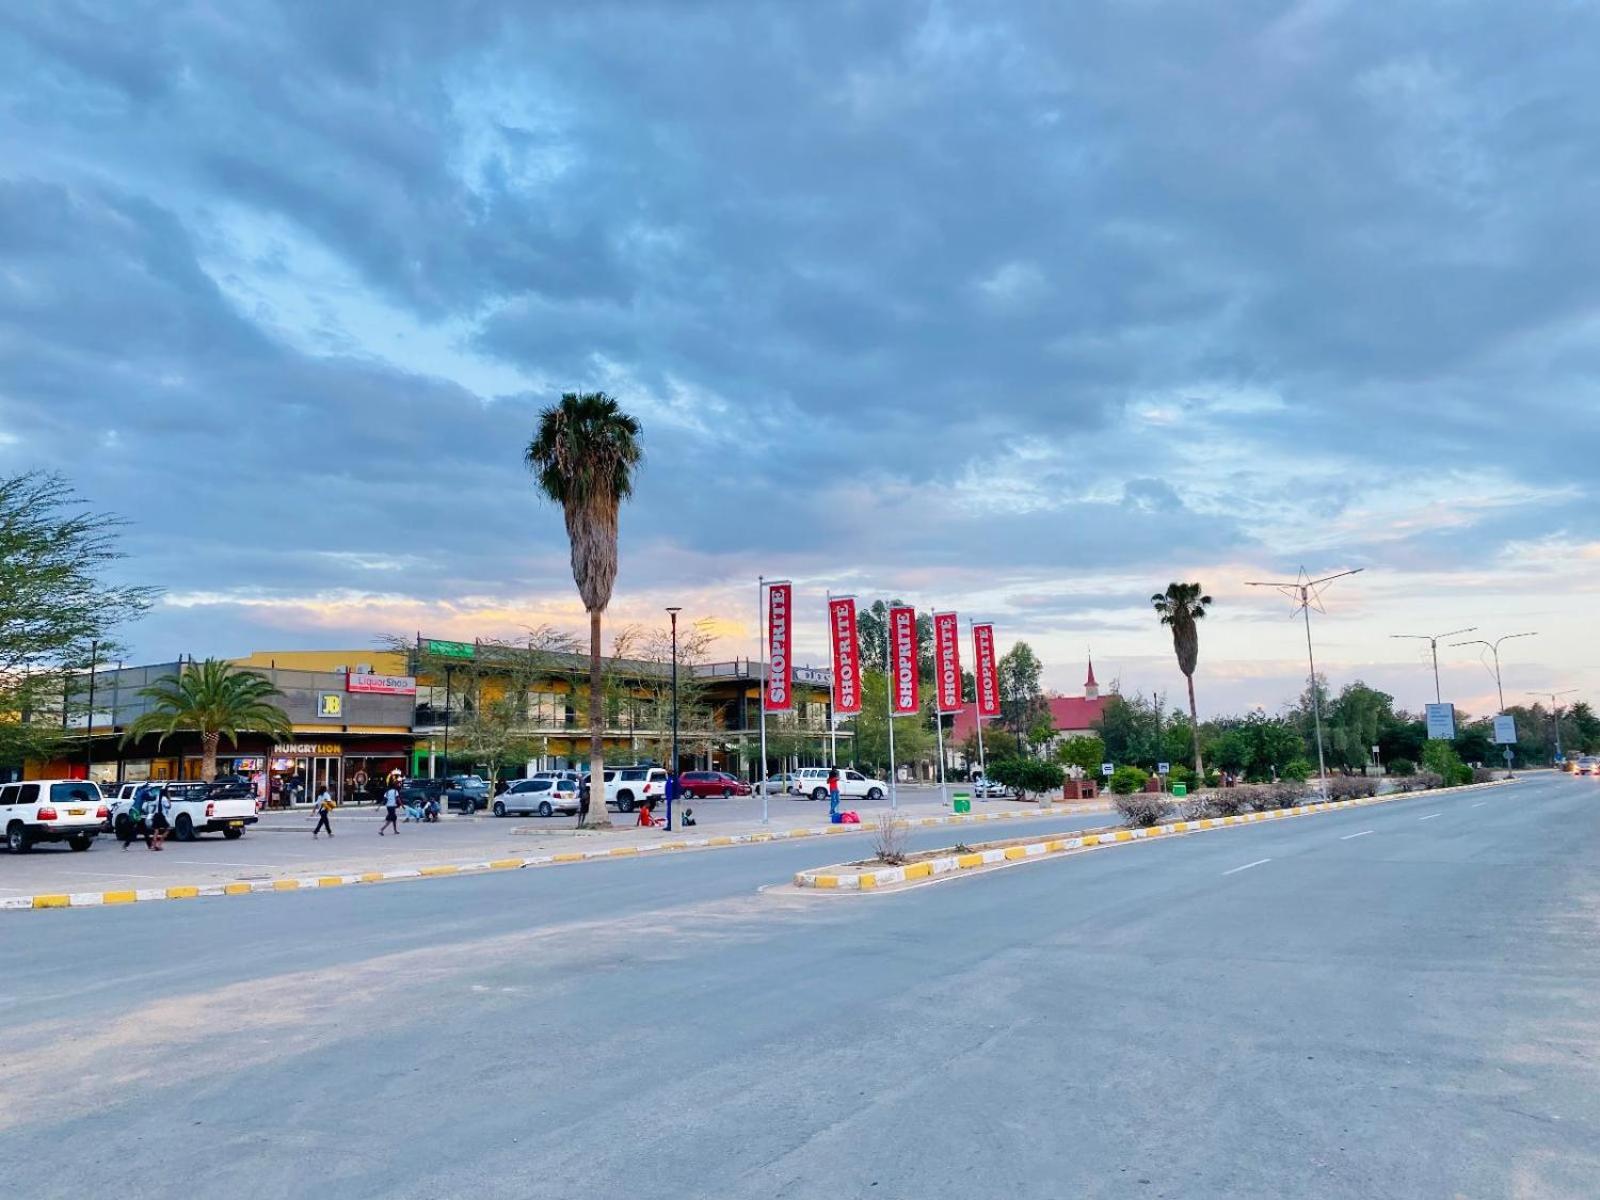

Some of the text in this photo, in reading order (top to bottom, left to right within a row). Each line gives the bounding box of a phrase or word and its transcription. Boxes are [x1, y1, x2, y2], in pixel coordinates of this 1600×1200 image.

[770, 589, 786, 703] SHOPRITE
[836, 604, 854, 707] SHOPRITE
[897, 612, 913, 708] SHOPRITE
[941, 618, 957, 706] SHOPRITE
[979, 629, 995, 711] SHOPRITE
